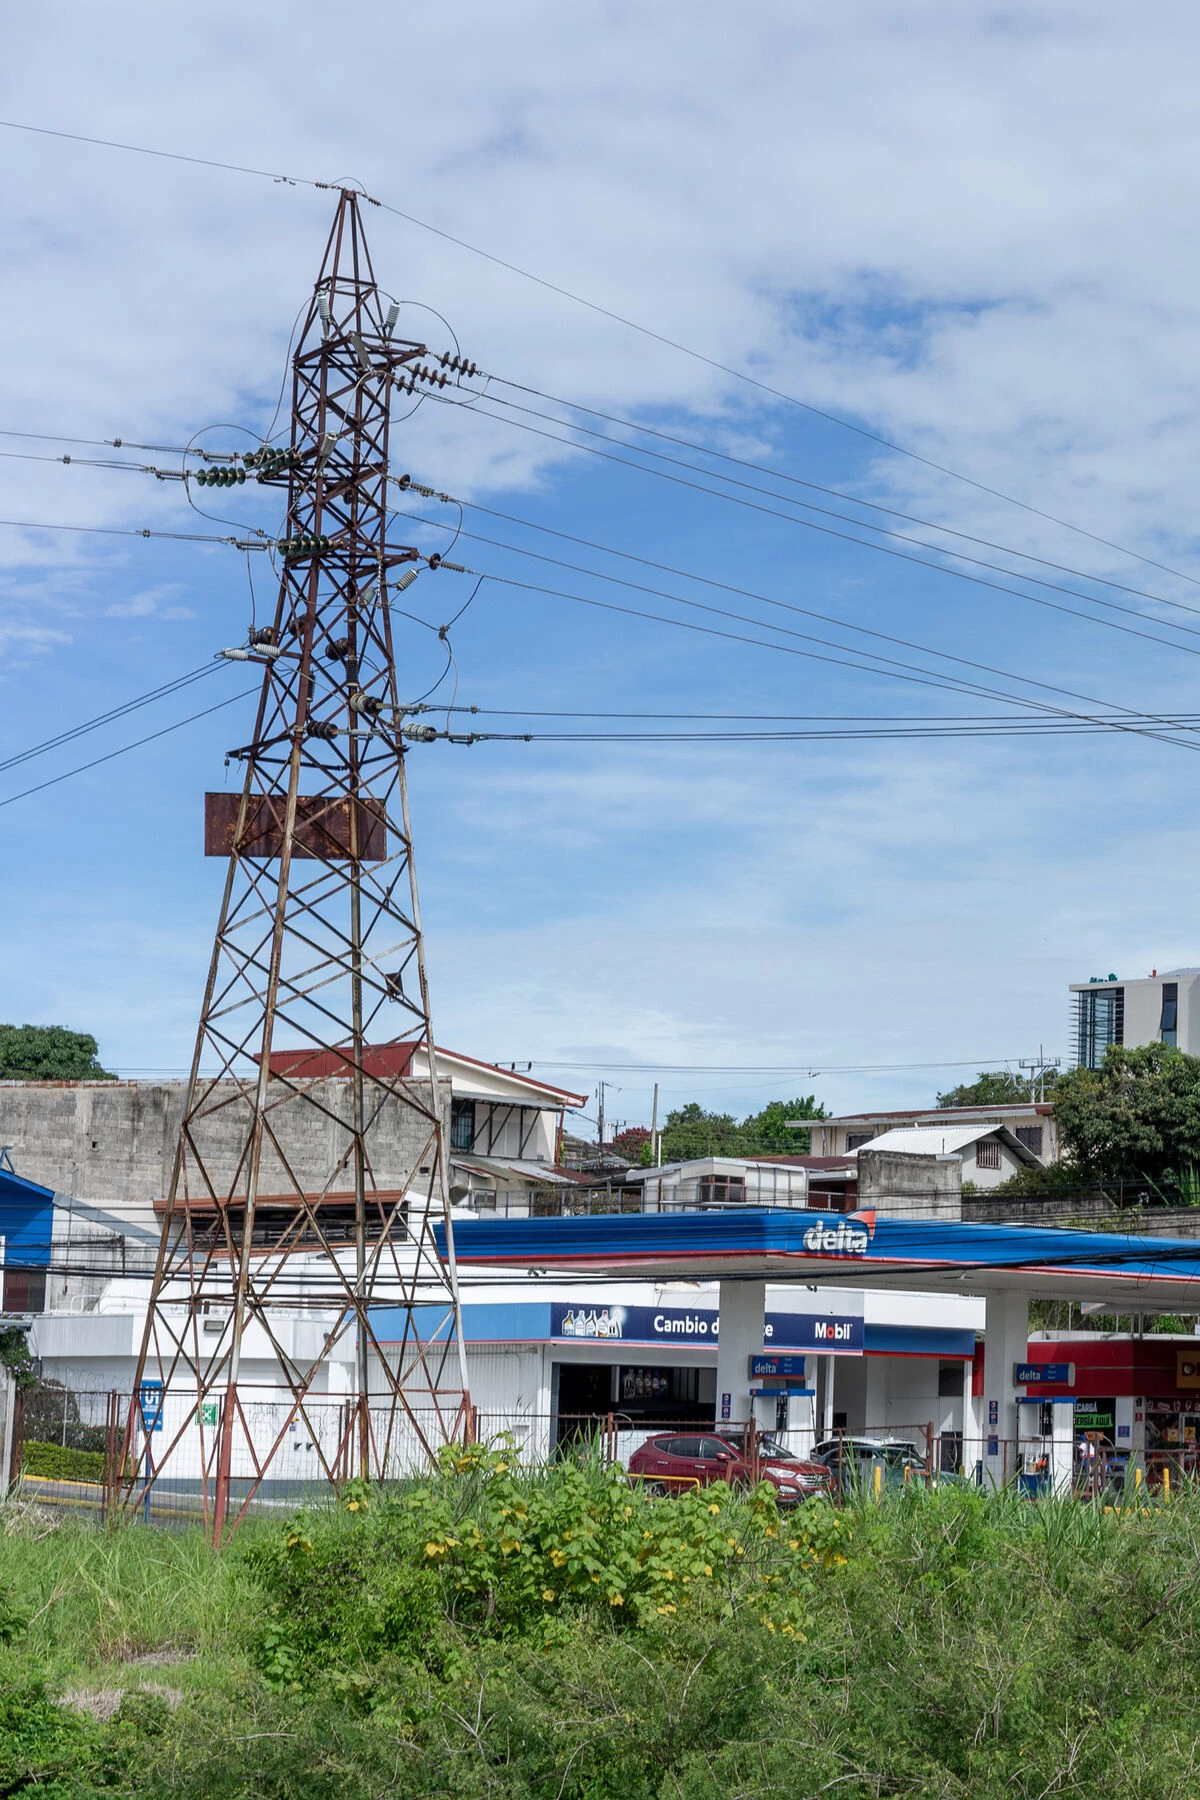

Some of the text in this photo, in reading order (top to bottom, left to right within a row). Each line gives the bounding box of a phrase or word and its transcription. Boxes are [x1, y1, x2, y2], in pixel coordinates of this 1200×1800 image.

[803, 1220, 867, 1253] delta
[653, 1315, 850, 1339] Cambio d Mobil
[755, 1362, 776, 1373] delta
[1019, 1370, 1041, 1380] delta
[1074, 1401, 1098, 1412] ECARGÁ
